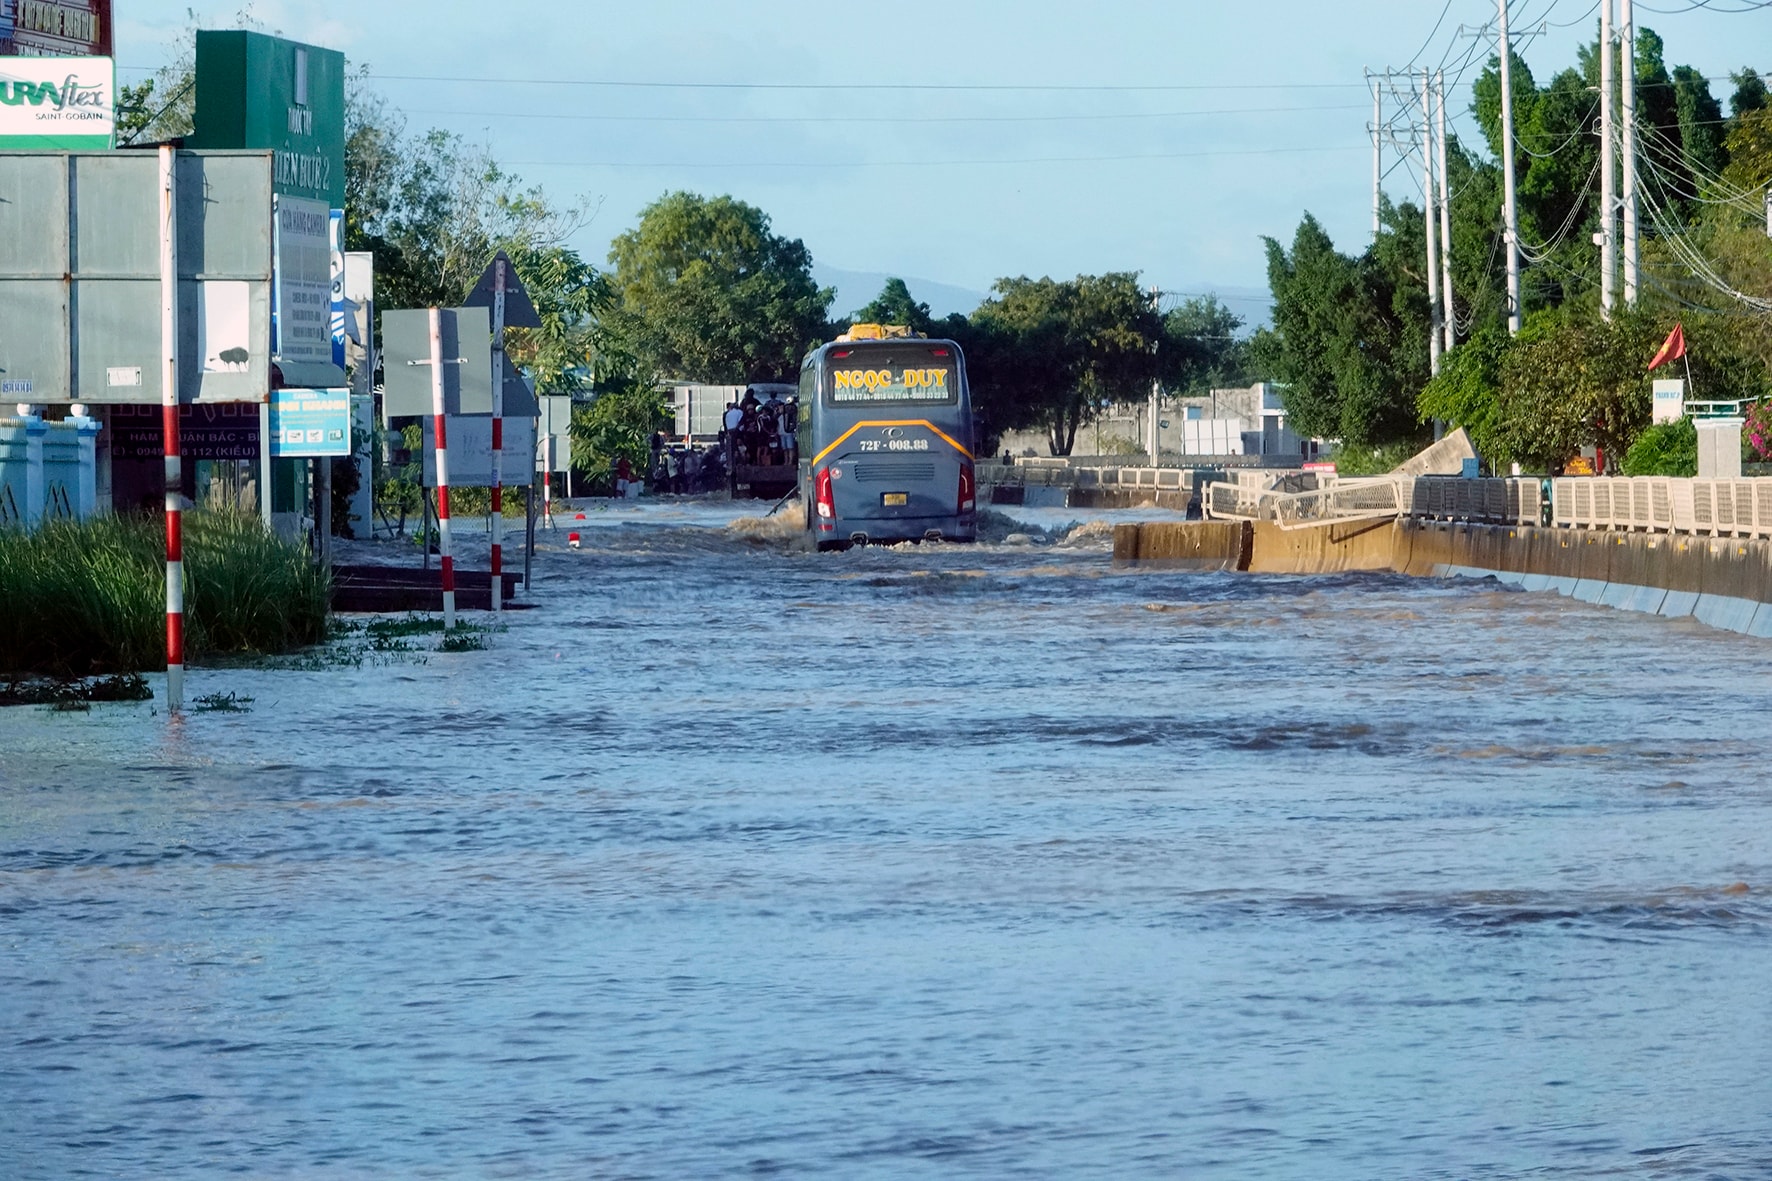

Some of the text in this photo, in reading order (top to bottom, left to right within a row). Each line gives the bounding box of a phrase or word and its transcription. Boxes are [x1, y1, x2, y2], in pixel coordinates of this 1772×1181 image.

[322, 156, 330, 191] 2
[834, 368, 948, 393] NGỌC DUY
[130, 431, 158, 441] HÀM
[209, 430, 236, 442] BẮC
[860, 440, 881, 451] 72F
[889, 439, 929, 451] 008.88
[192, 447, 213, 456] 112
